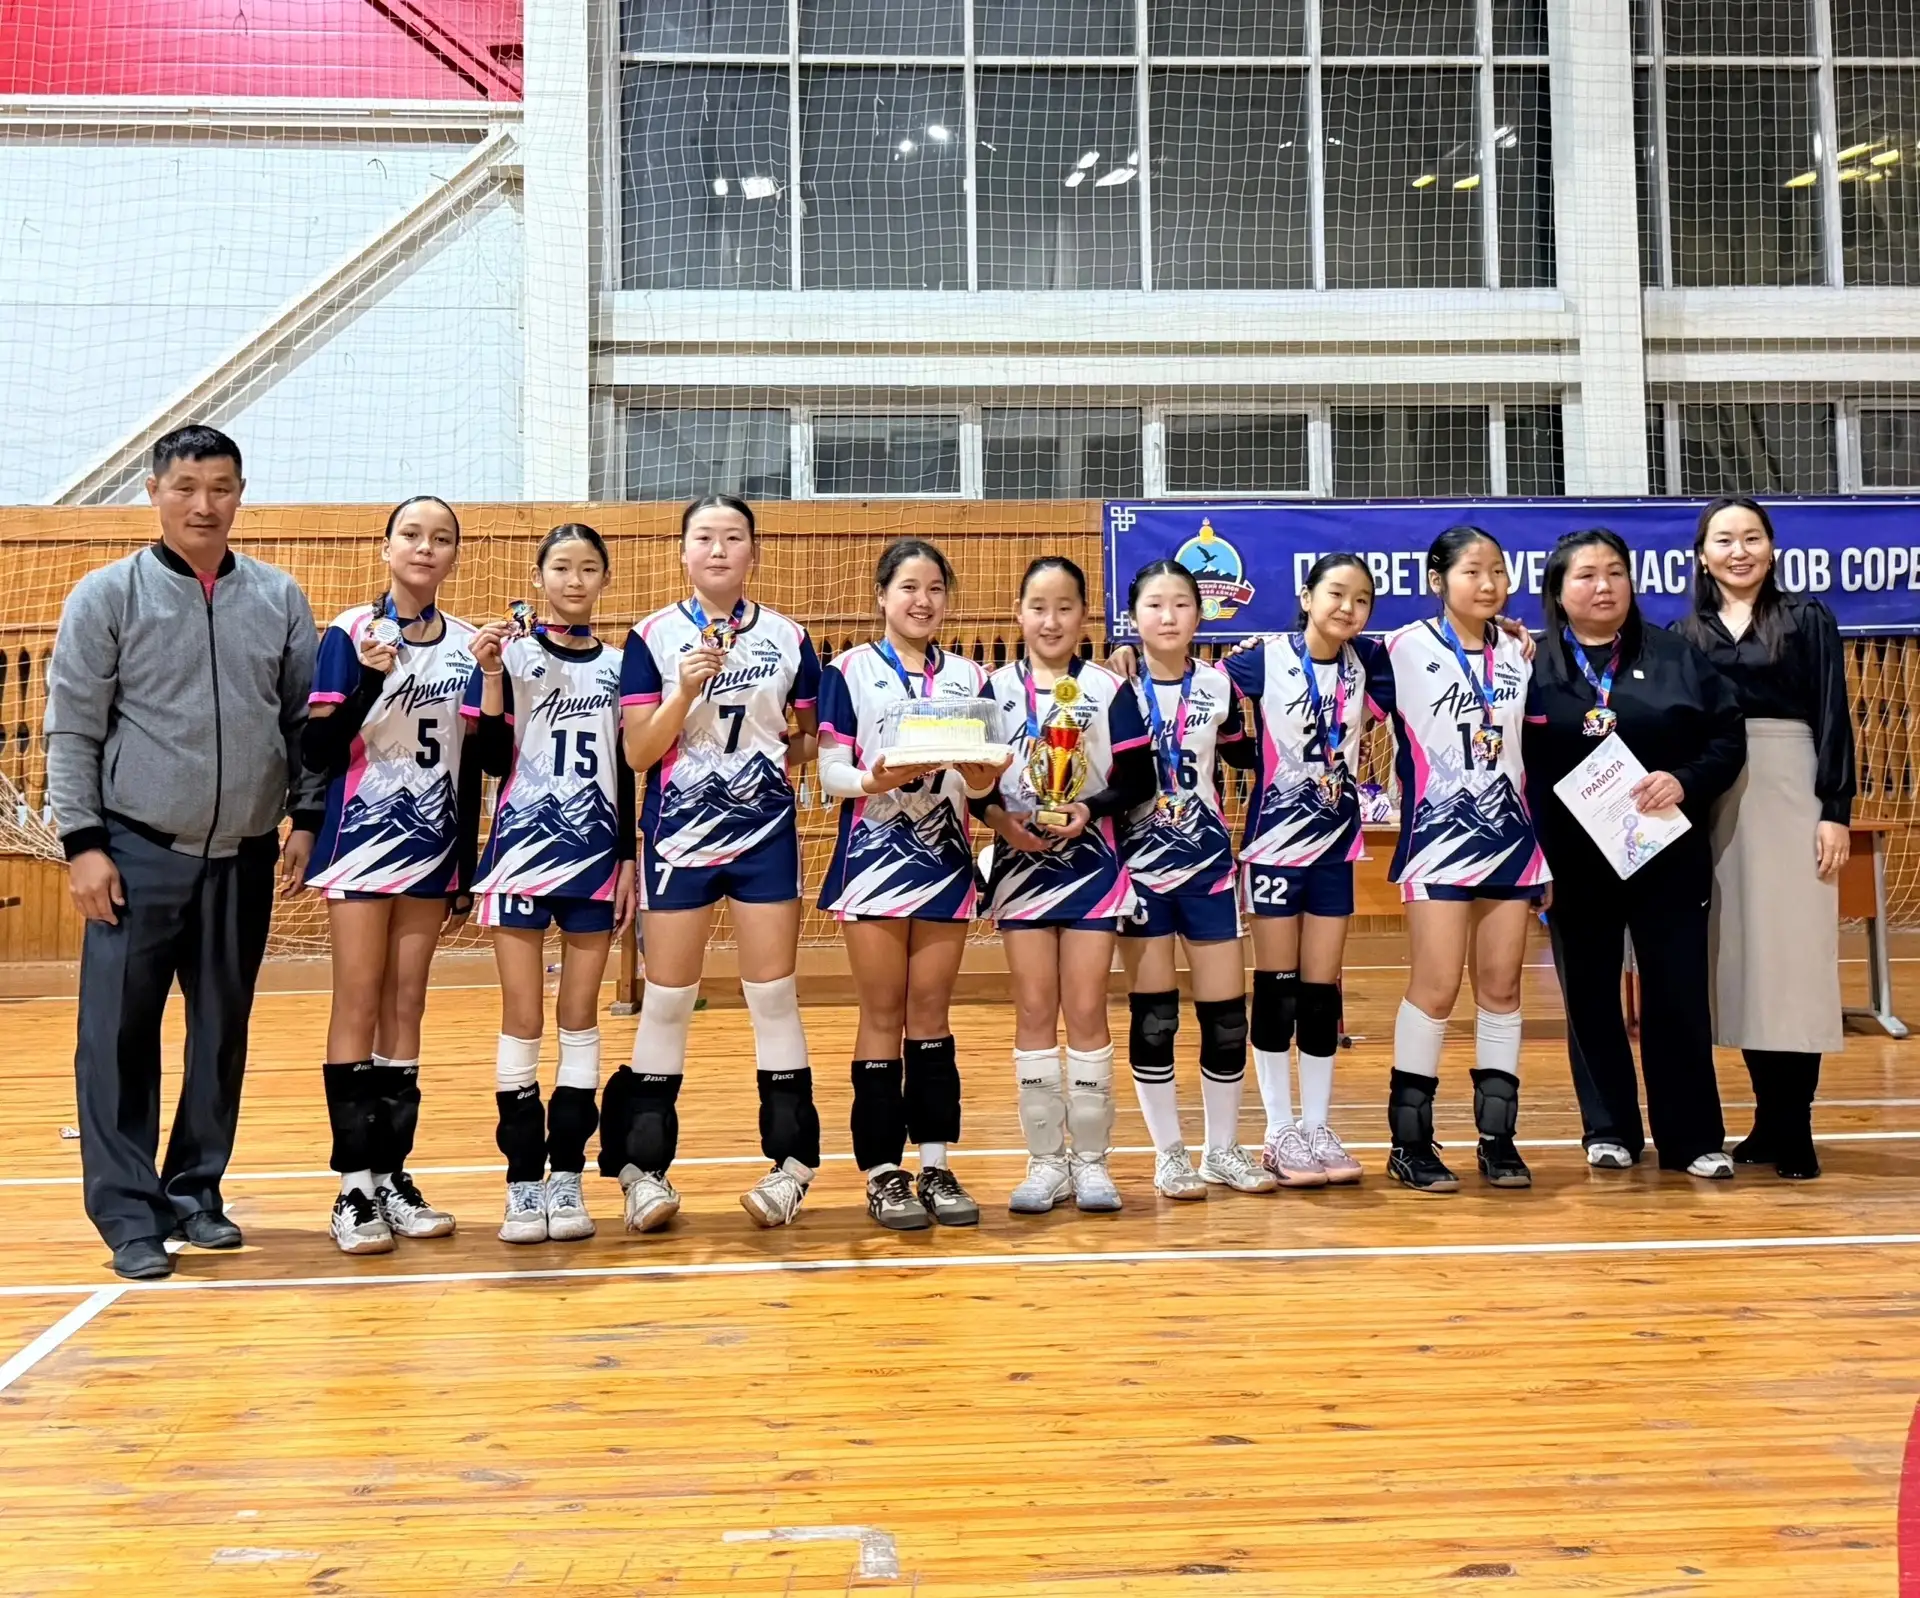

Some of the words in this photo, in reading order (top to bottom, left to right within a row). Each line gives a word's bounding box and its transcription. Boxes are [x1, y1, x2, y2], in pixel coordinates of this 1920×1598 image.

[701, 663, 779, 704] ршан
[1430, 682, 1519, 722] Аран
[416, 718, 441, 769] 5
[719, 705, 746, 754] 7
[551, 729, 598, 779] 15
[1581, 760, 1625, 800] ГРАМОТА
[655, 862, 674, 895] 7
[1253, 875, 1288, 905] 22
